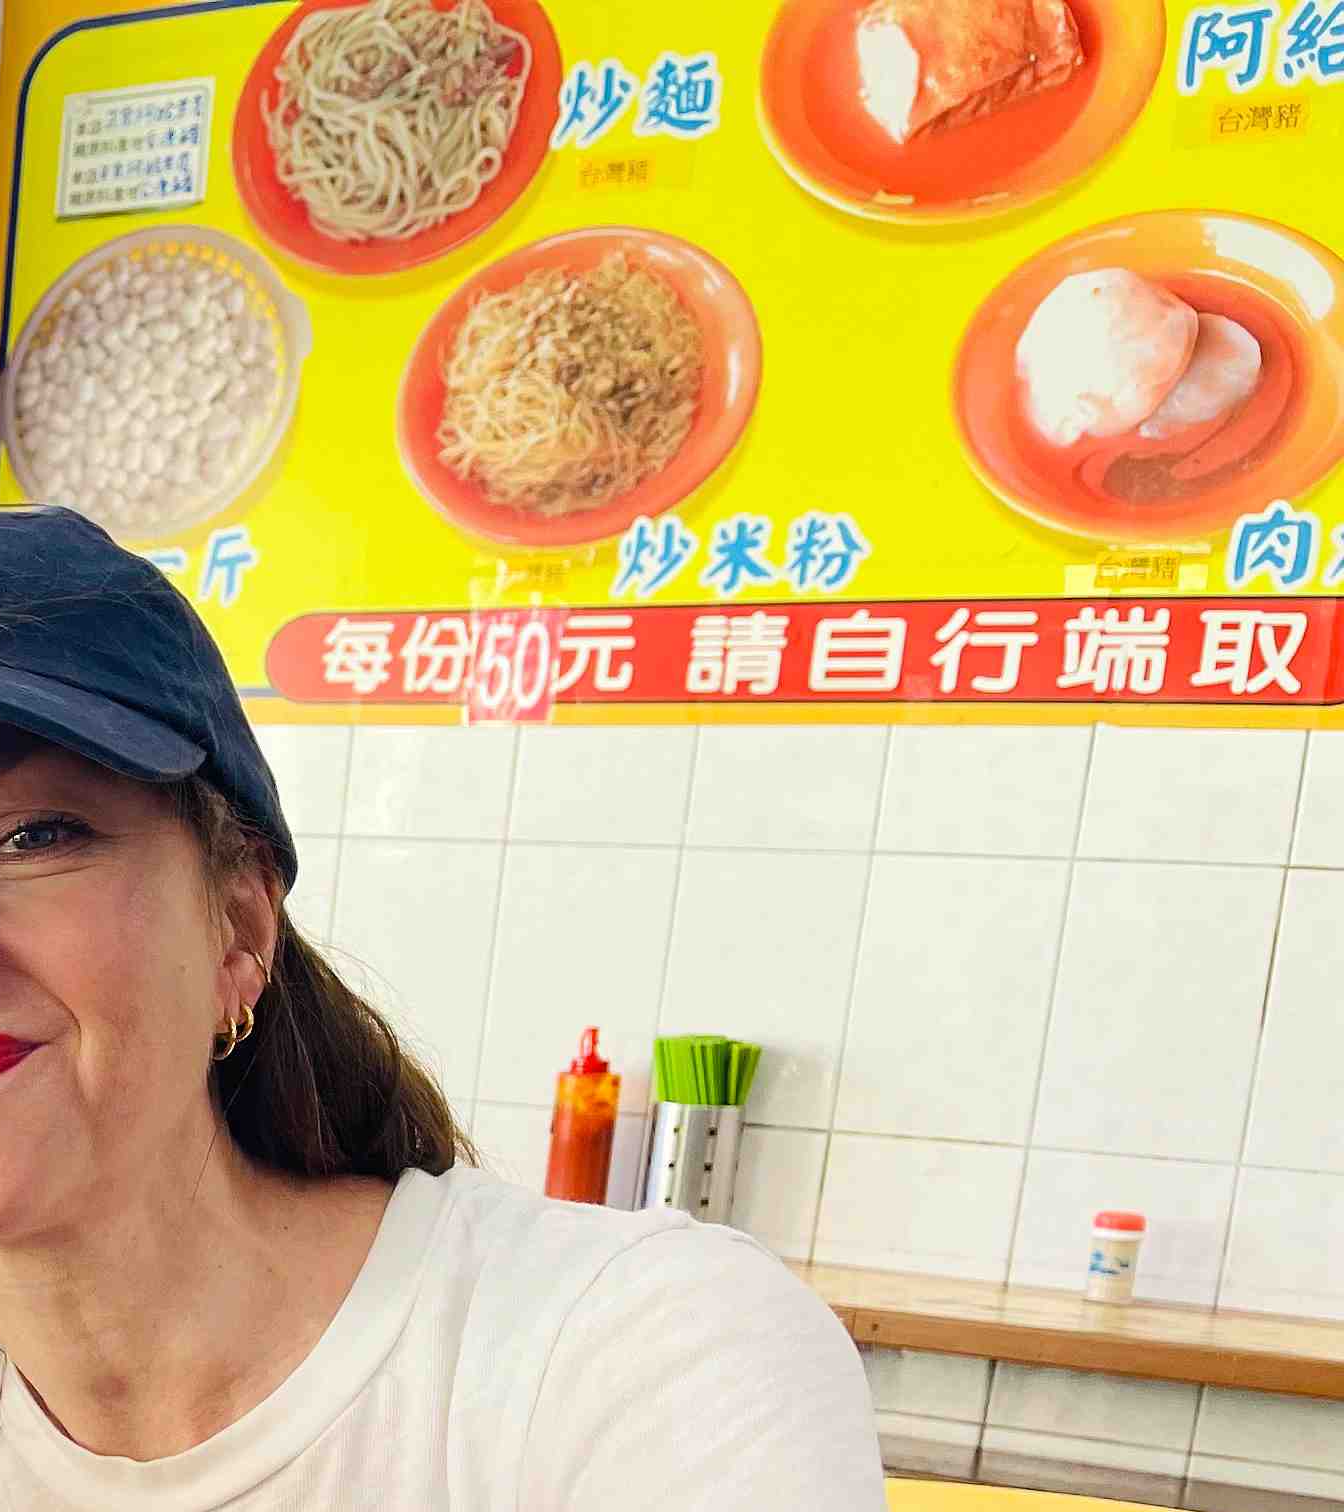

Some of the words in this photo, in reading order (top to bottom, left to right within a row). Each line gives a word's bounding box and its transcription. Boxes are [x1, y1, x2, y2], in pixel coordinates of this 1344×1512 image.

[1185, 1, 1344, 87] 阿給
[555, 60, 715, 140] 炒麵
[615, 519, 864, 592] 炒米粉
[1234, 507, 1344, 585] 肉
[685, 606, 1308, 696] 請自行端取
